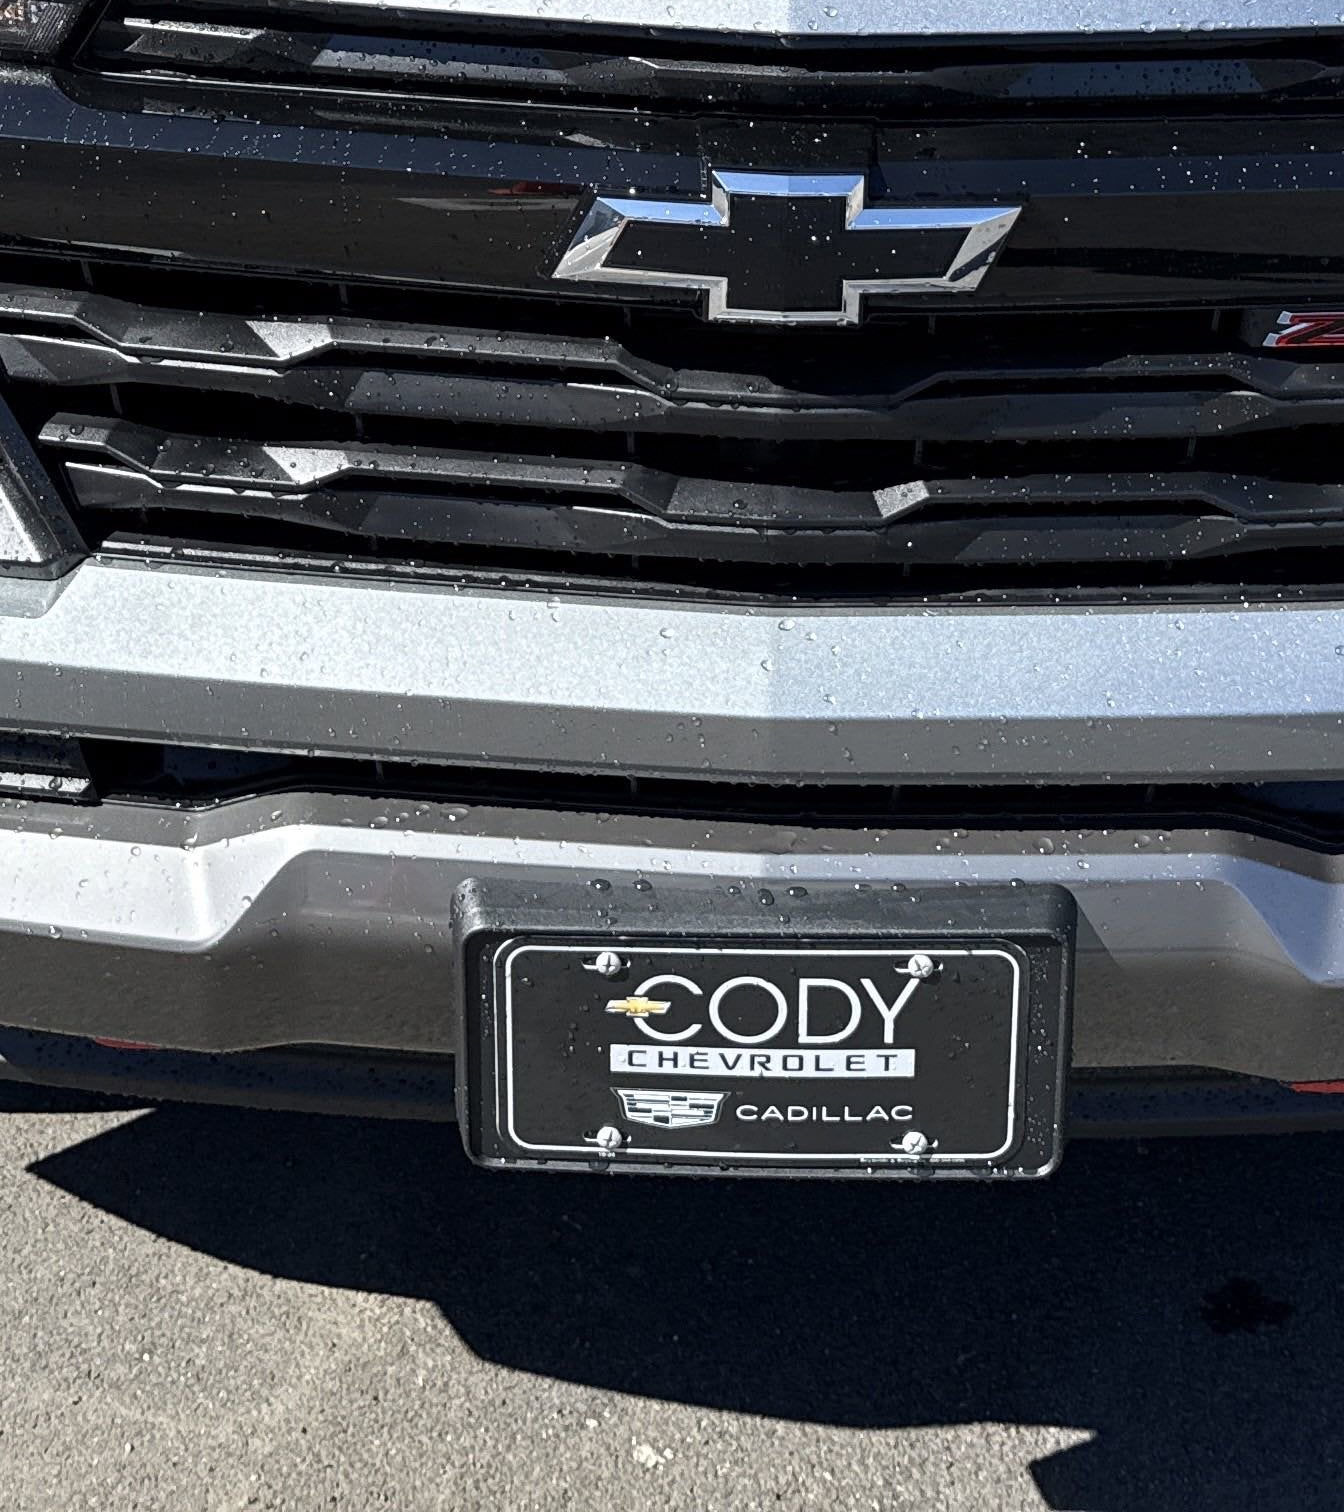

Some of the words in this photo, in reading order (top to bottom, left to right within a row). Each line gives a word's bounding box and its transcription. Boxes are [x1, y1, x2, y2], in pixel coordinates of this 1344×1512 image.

[633, 974, 920, 1044] CODY
[627, 1049, 898, 1073] CHEVROLET
[735, 1104, 913, 1122] CADILLAC
